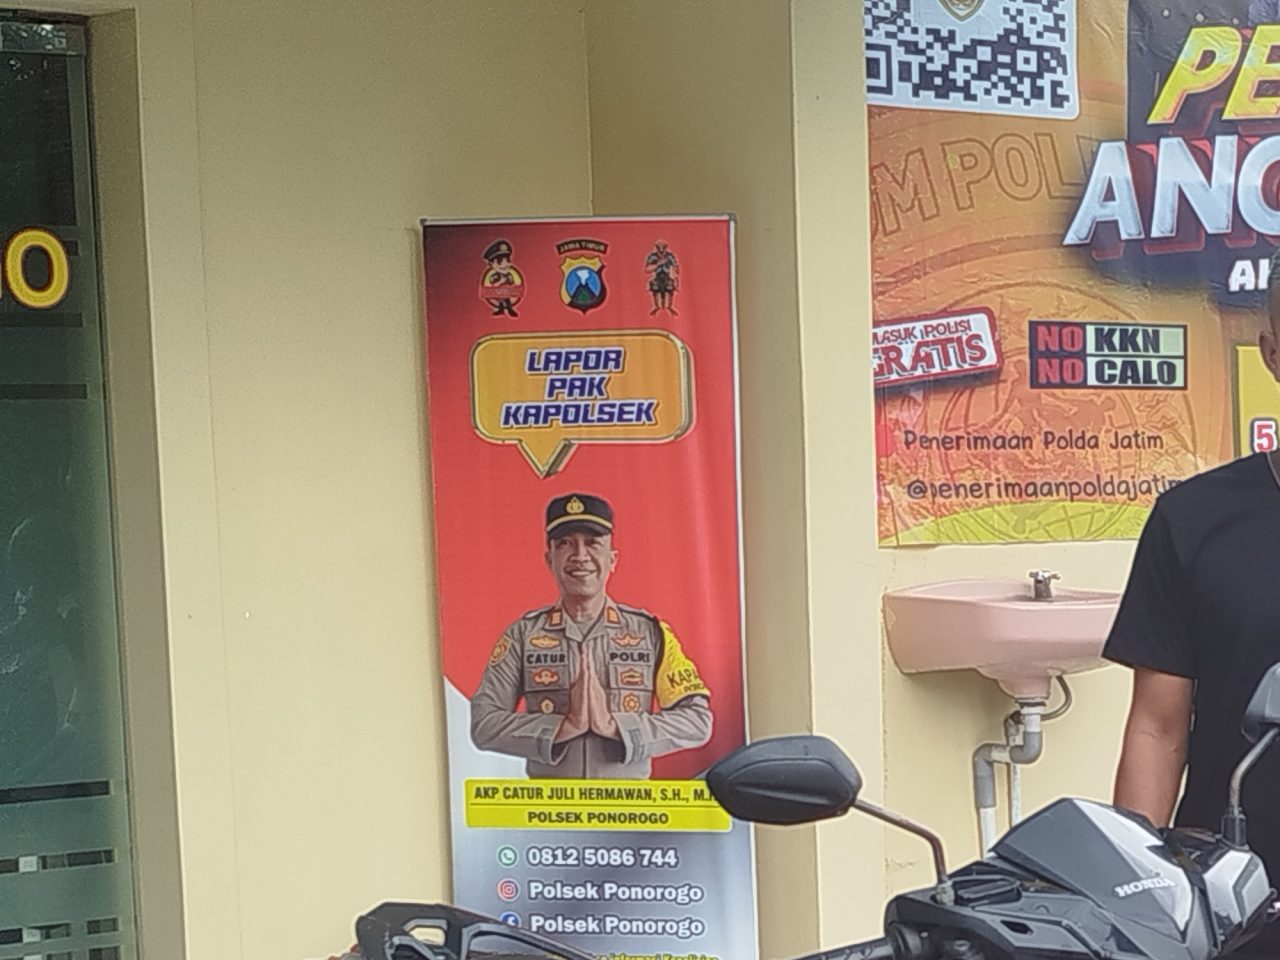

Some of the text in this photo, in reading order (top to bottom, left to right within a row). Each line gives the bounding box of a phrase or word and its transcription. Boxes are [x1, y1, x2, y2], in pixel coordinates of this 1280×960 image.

[1036, 324, 1161, 354] NO KKN
[526, 349, 624, 374] LAPOR
[1037, 357, 1177, 386] NO CALO
[547, 375, 608, 399] PAK
[501, 400, 658, 428] KAPOLSEK
[903, 429, 1165, 450] Penerimaan Polda Jatim
[526, 653, 566, 664] CATUR
[609, 652, 651, 663] POLRI
[474, 787, 500, 800] AKP
[503, 787, 544, 800] CATUR
[547, 787, 575, 801] JULI
[579, 787, 657, 803] HERMAWAN,
[527, 811, 669, 825] POLSEK PONOROGO
[527, 847, 678, 866] 0812 5086 744
[529, 881, 703, 904] Polsek Ponorogo
[1114, 878, 1176, 897] HONDA
[531, 915, 705, 938] Polsek Ponorogo
